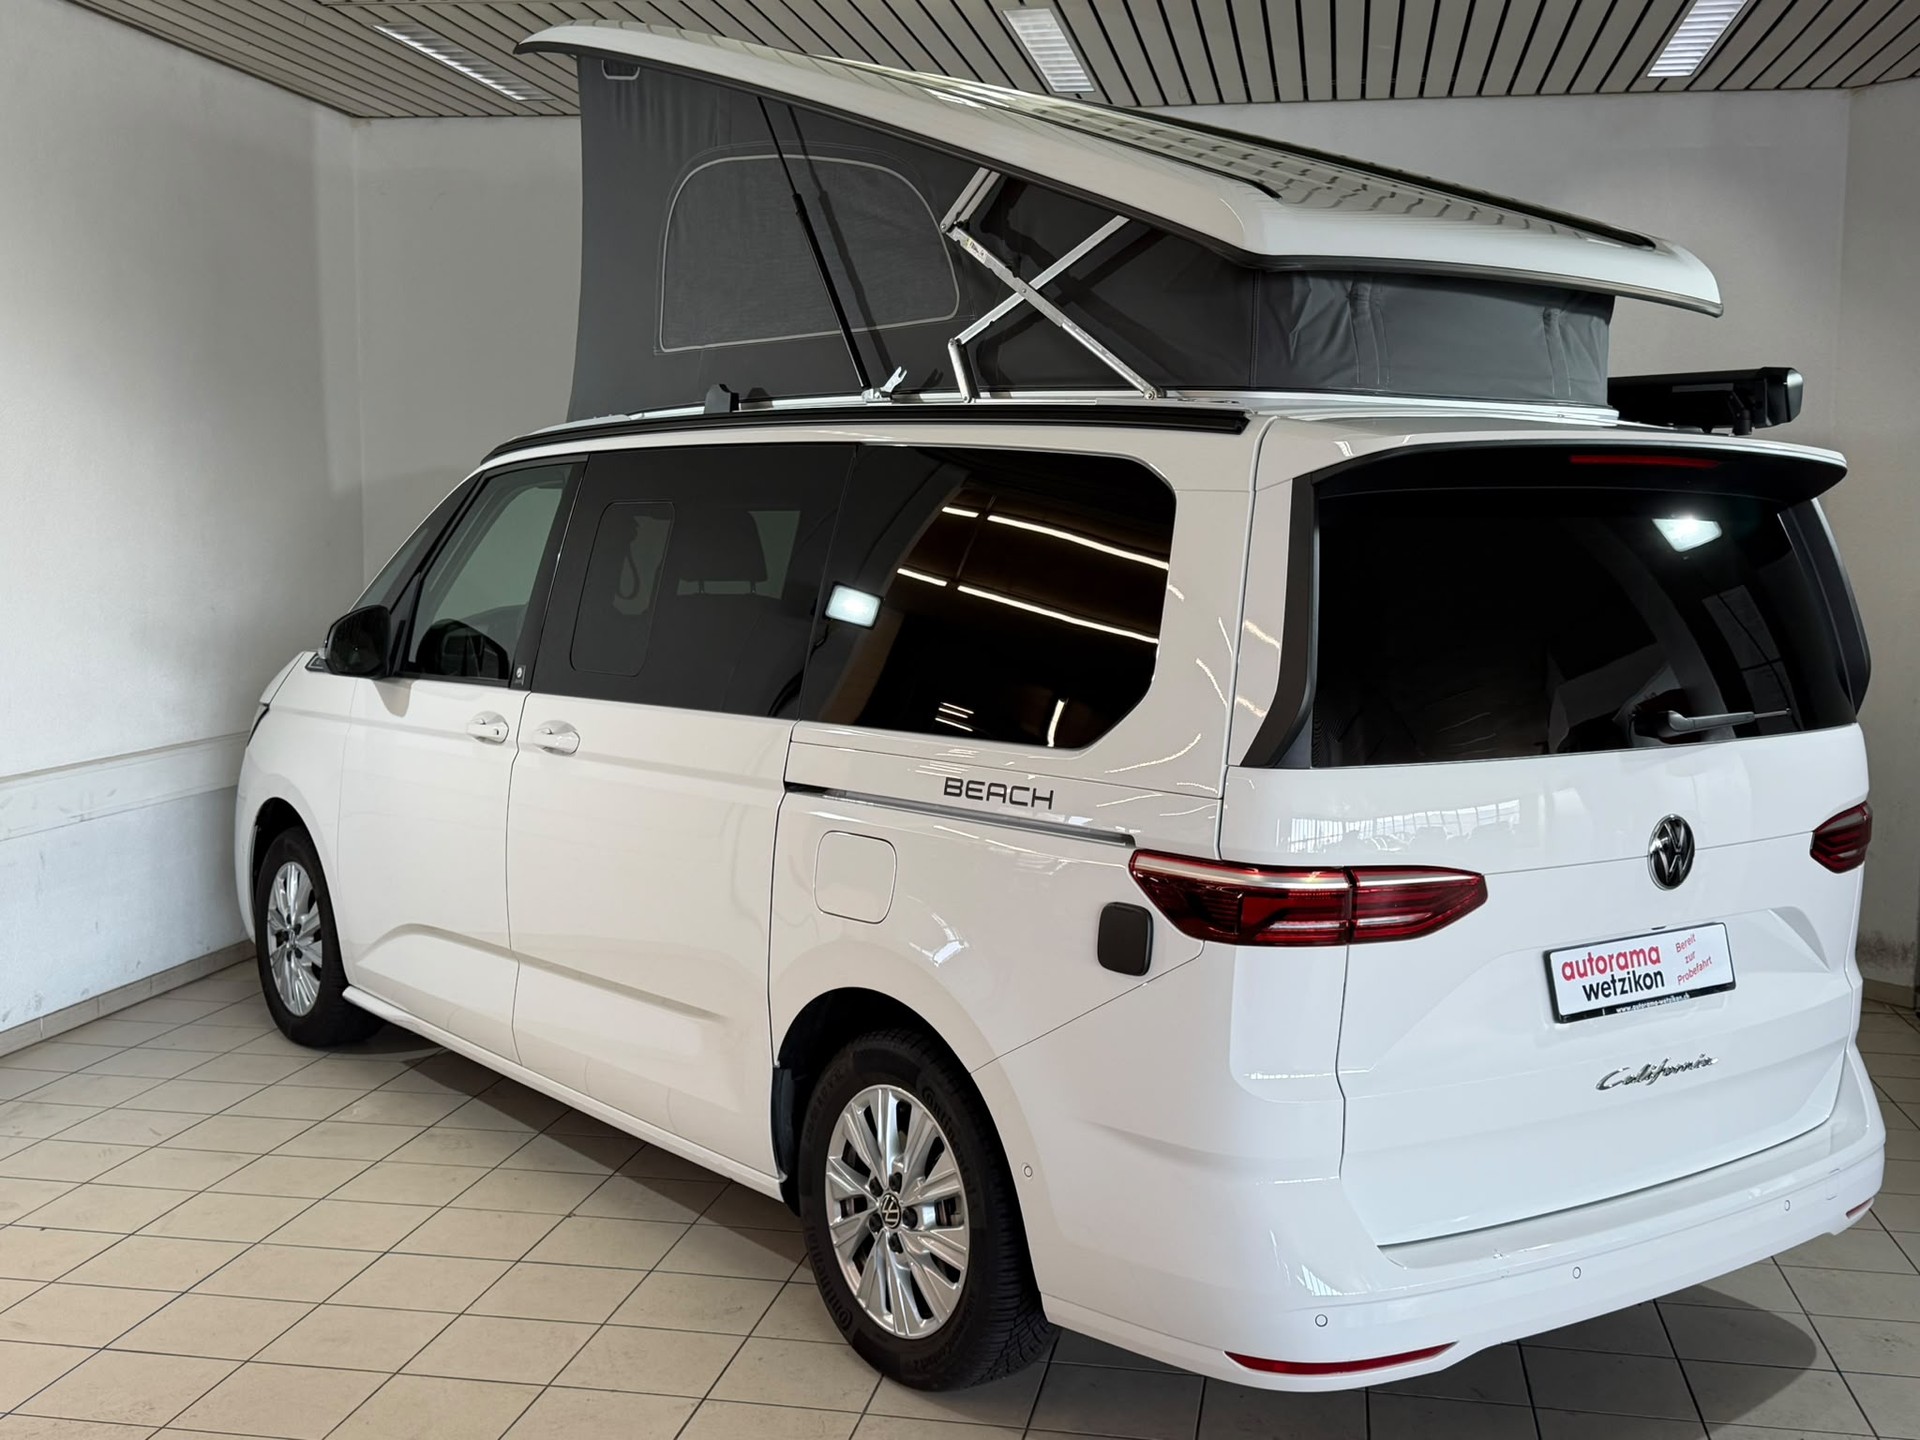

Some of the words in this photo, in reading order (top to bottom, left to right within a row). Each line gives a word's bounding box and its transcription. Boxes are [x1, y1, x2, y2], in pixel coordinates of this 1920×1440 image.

[943, 776, 1055, 810] BEACH
[1675, 933, 1697, 953] Bereit
[1684, 950, 1697, 964] zur
[1561, 945, 1661, 981] autorama
[1677, 955, 1713, 985] Probefahrt
[1582, 969, 1665, 1002] wetzikon
[1595, 1053, 1719, 1091] California
